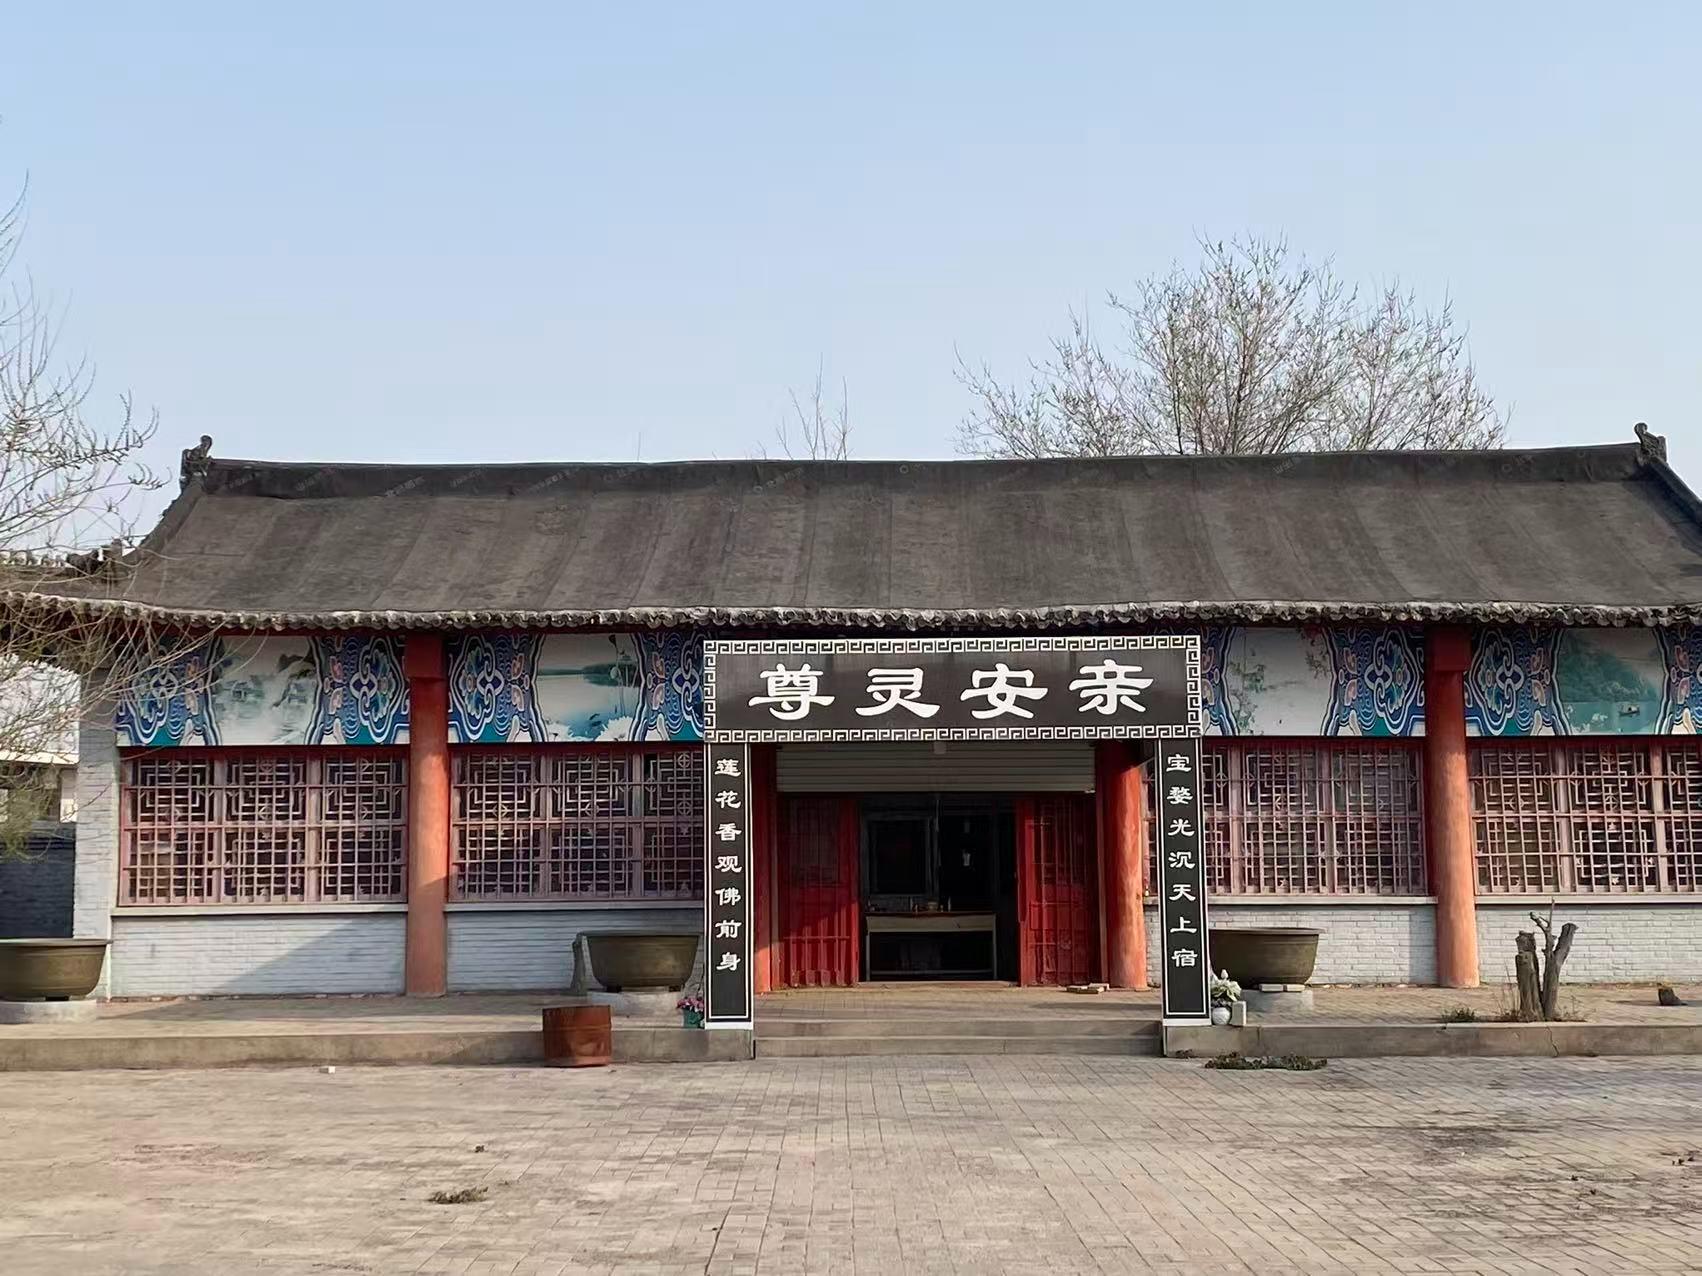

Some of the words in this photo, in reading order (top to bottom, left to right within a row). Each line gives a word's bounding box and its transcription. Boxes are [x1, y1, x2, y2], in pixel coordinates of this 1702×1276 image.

[714, 758, 742, 971] 莲花香观佛前身
[1165, 753, 1198, 967] 宝婺光沉天上宿
